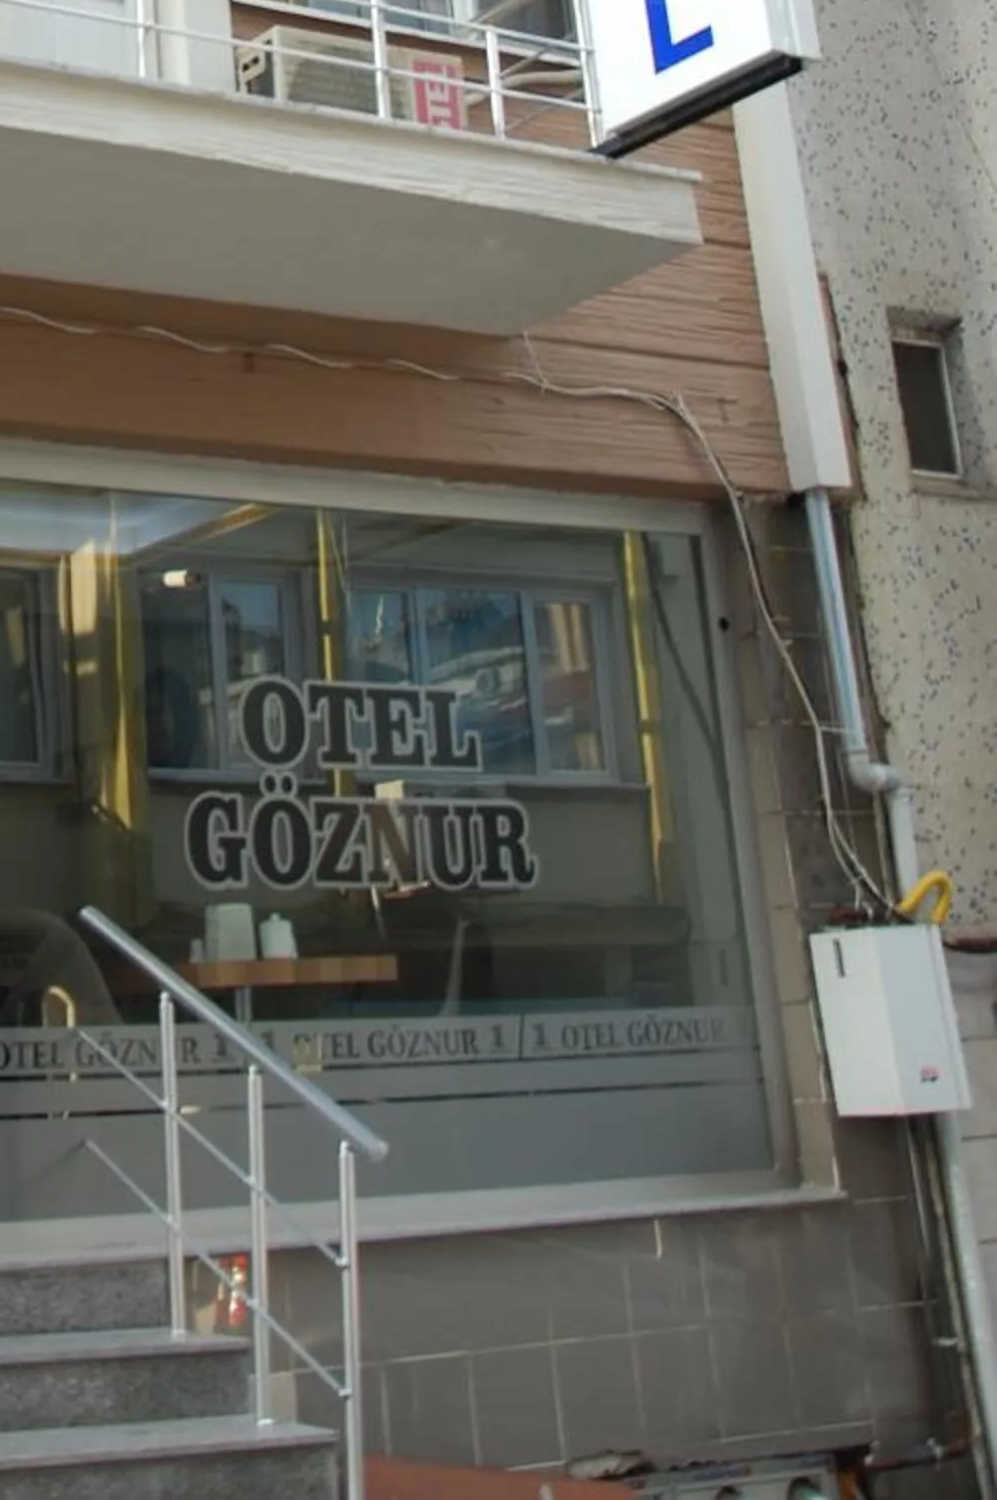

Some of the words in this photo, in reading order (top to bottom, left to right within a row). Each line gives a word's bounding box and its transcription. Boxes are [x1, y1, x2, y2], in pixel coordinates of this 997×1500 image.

[239, 675, 482, 771] OTEL
[184, 769, 539, 890] GÖZNUR
[74, 1031, 201, 1071] GÖZNR
[367, 1024, 481, 1058] GÖZNUR
